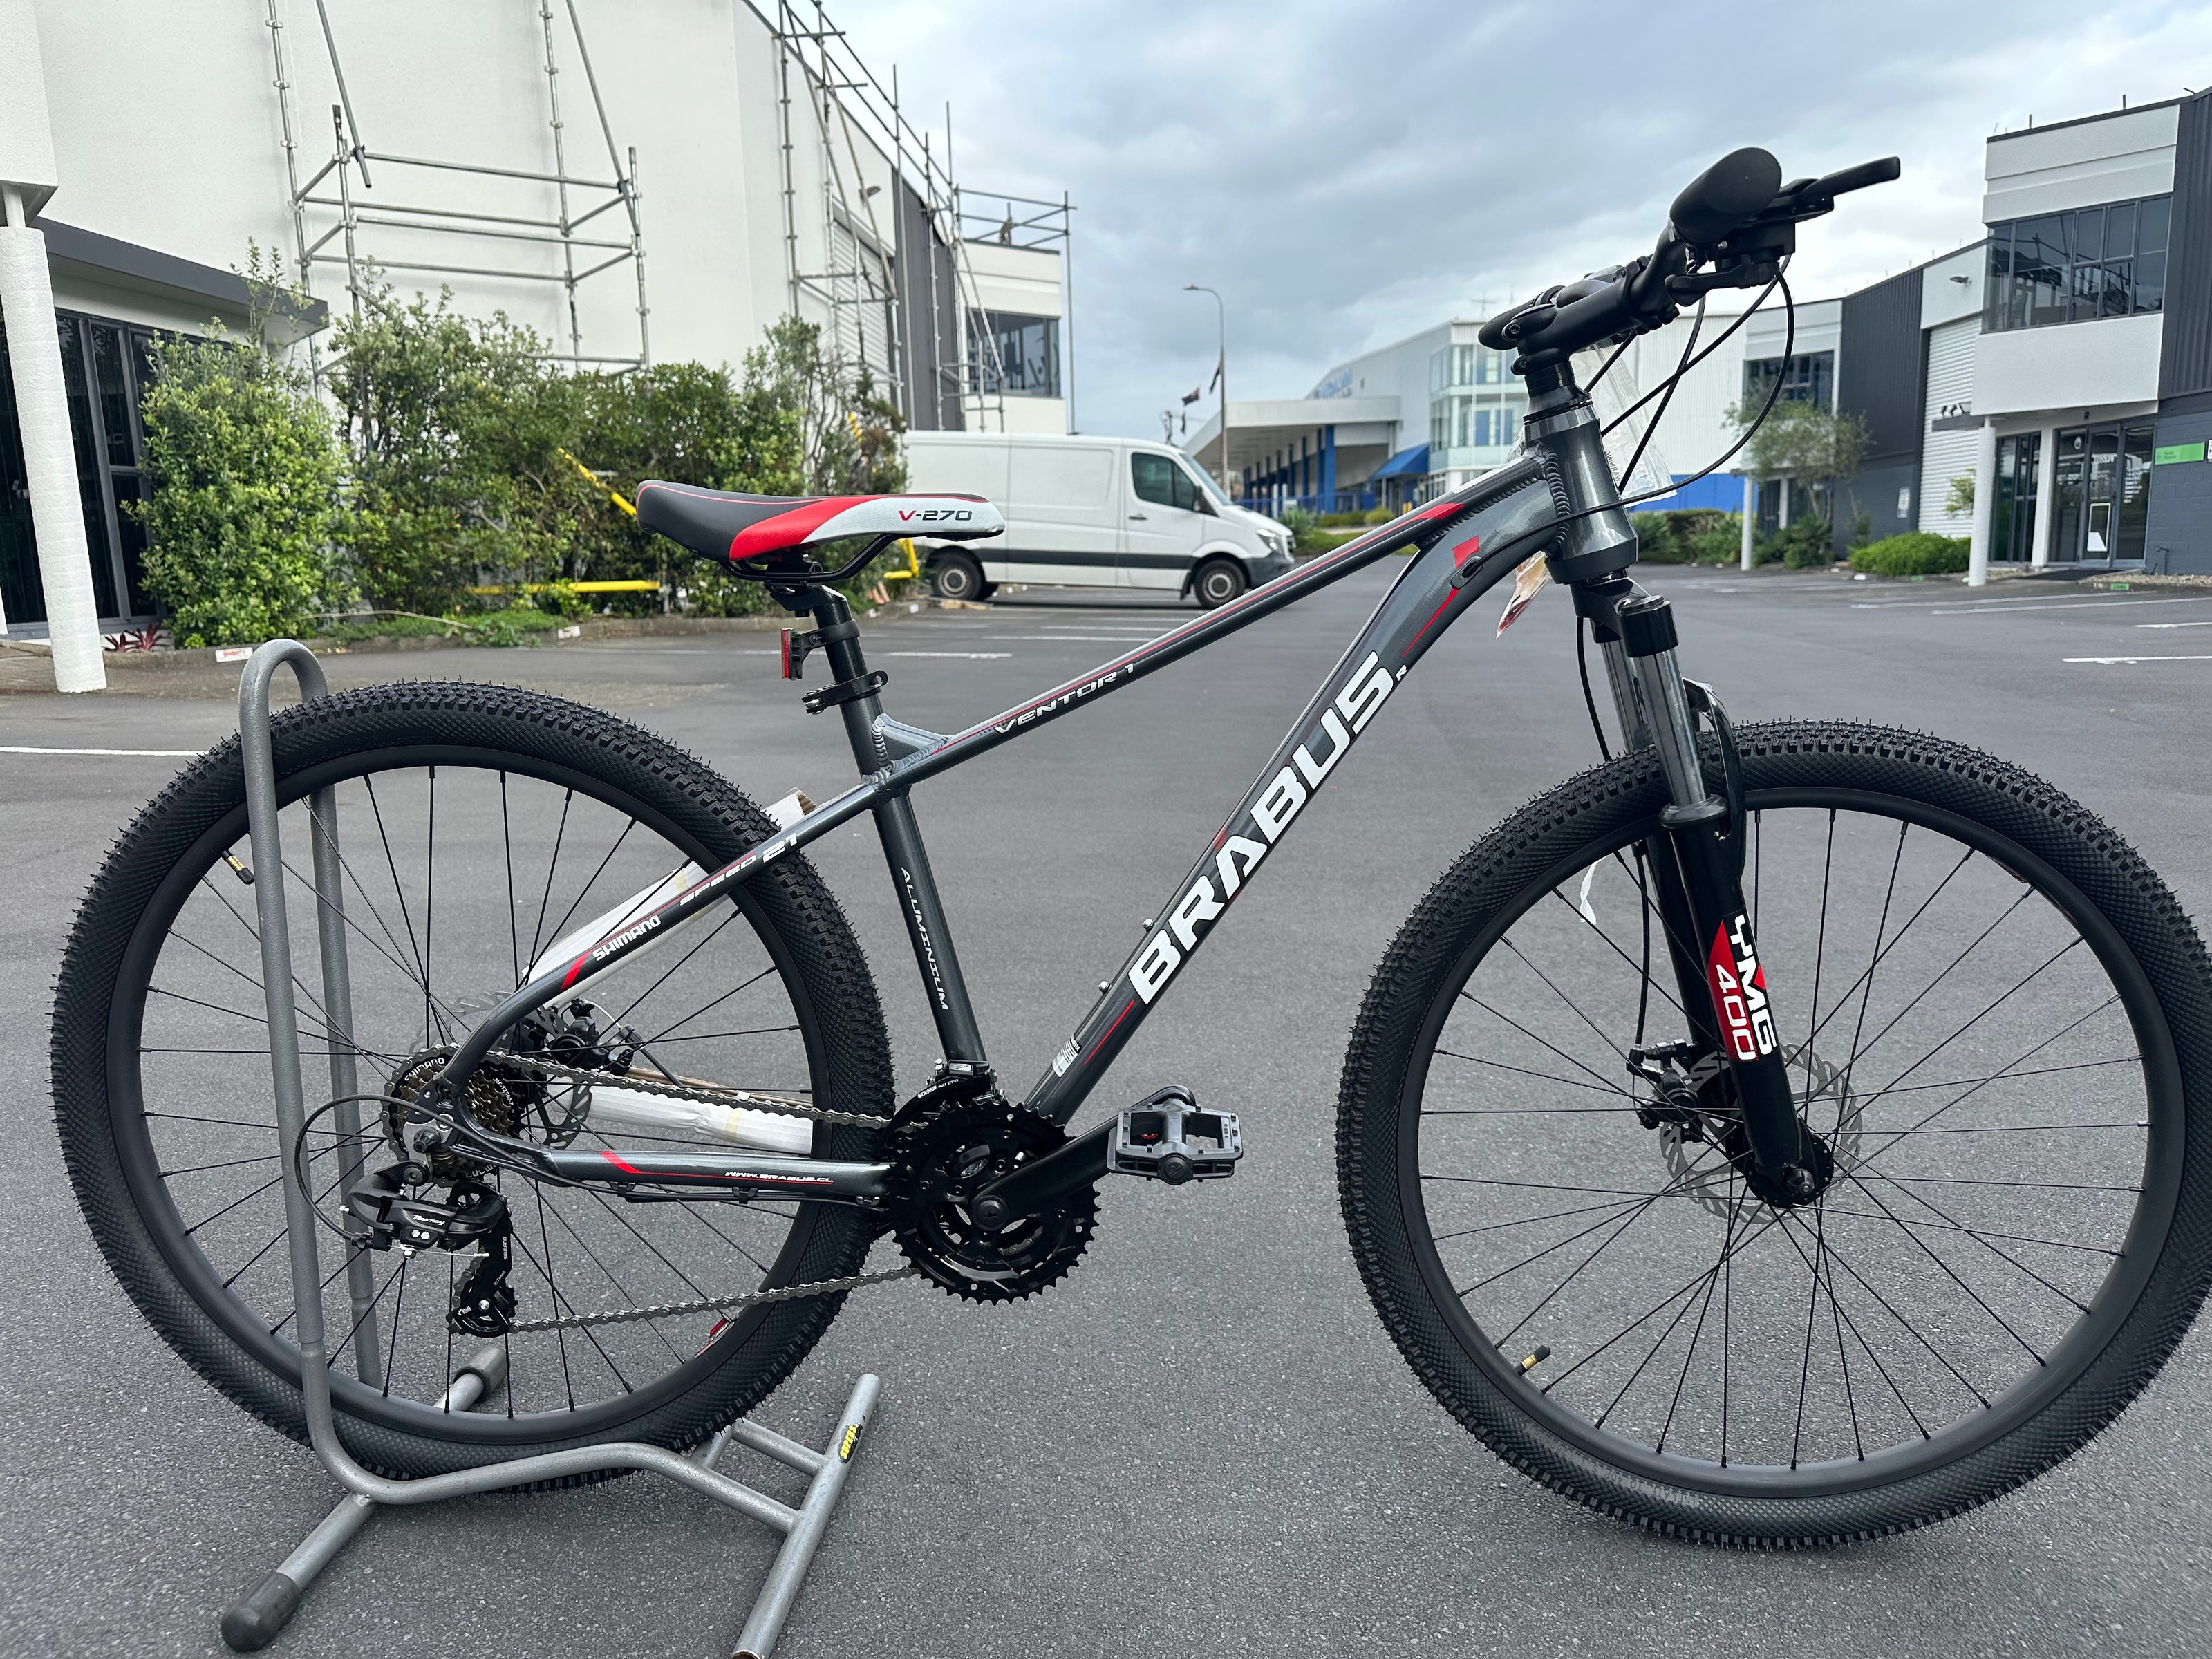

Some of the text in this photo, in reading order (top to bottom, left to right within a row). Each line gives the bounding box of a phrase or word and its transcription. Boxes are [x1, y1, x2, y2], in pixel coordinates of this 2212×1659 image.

[899, 510, 973, 521] V-270
[994, 663, 1134, 734] VENTOR 1
[1127, 650, 1394, 1005] BRABUS
[592, 832, 798, 962] SHIMANO SPEED 21
[901, 867, 949, 1011] ALUMINIUM
[1716, 964, 1756, 1060] 400
[724, 1171, 834, 1183] WWW.BRABUS.CL
[413, 1214, 446, 1226] Tourney
